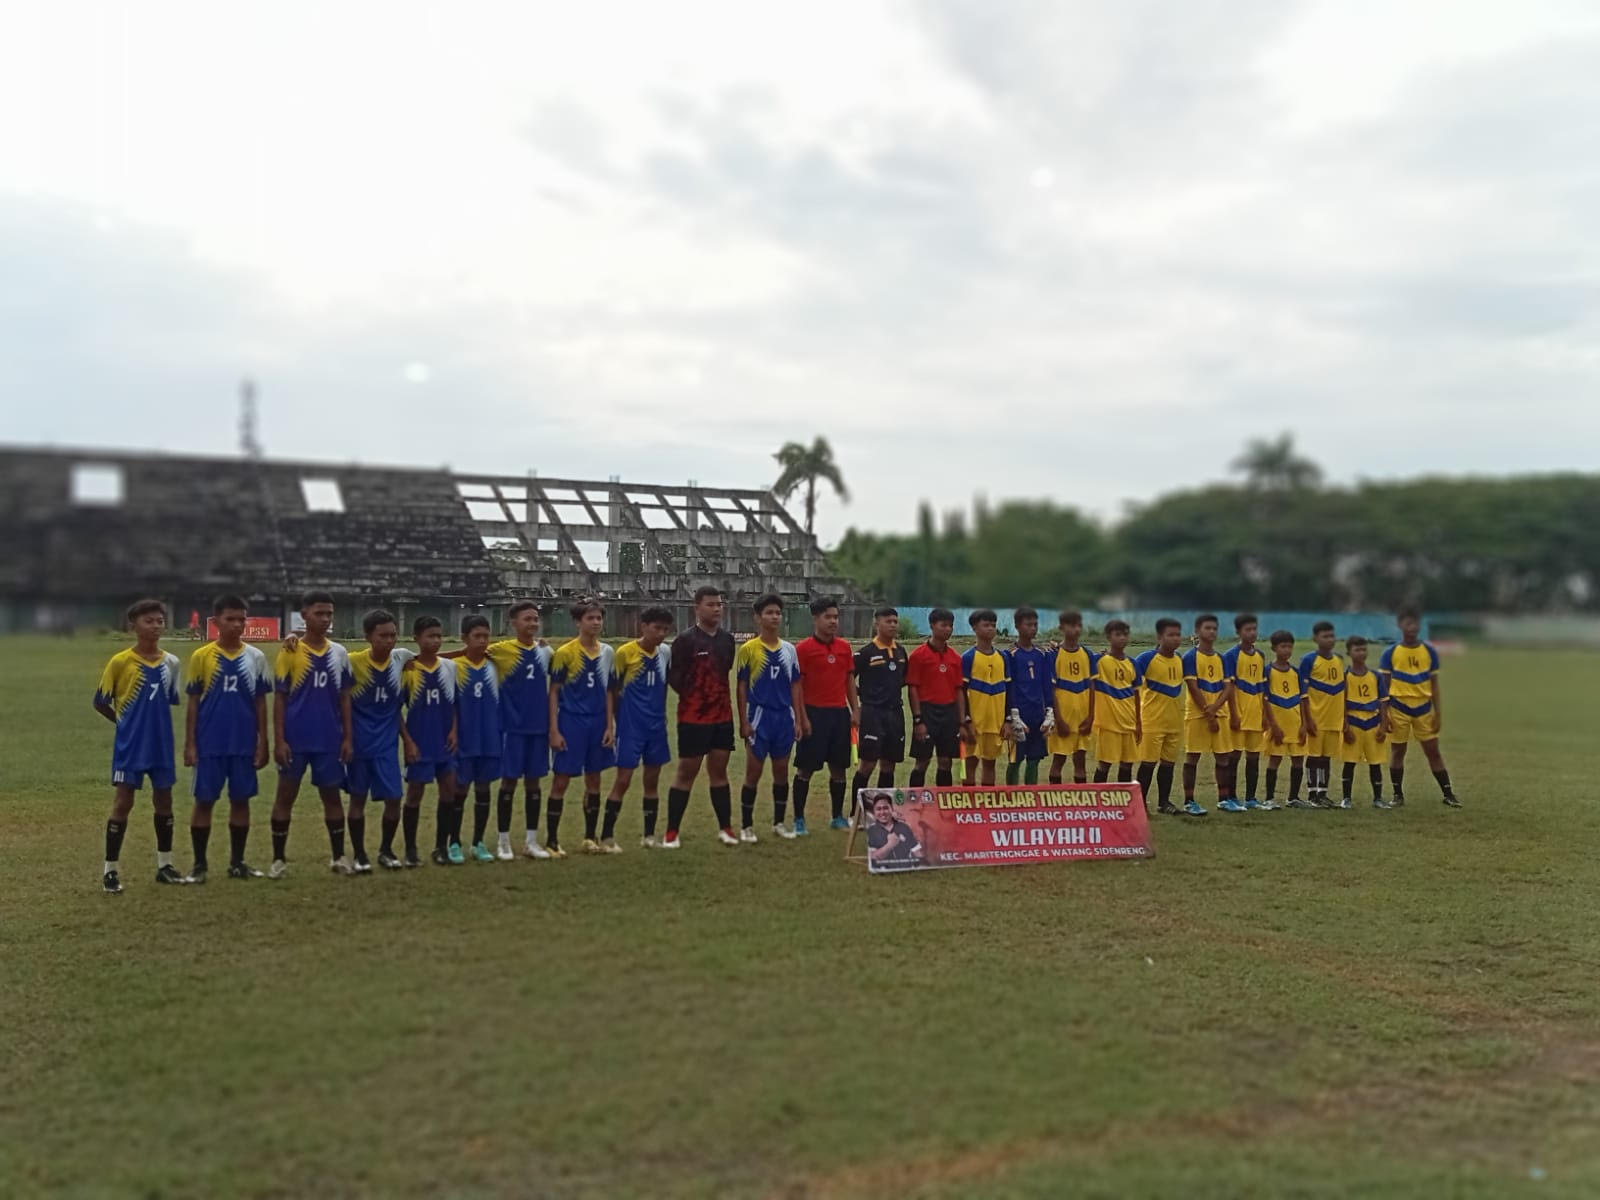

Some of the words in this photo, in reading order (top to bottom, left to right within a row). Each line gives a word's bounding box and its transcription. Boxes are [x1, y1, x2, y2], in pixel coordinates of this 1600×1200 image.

[249, 626, 270, 636] PSSI
[1069, 661, 1080, 676] 19
[1408, 655, 1419, 669] 14
[526, 665, 535, 680] 2
[770, 665, 781, 680] 17
[987, 664, 995, 679] 7
[1028, 666, 1035, 680] 1
[1114, 667, 1125, 682] 13
[1168, 667, 1177, 681] 11
[1207, 665, 1215, 678] 3
[1248, 663, 1258, 677] 17
[1327, 667, 1338, 681] 10
[223, 675, 238, 692] 12
[313, 671, 328, 688] 10
[587, 672, 595, 688] 5
[646, 671, 656, 687] 11
[149, 683, 159, 701] 7
[474, 682, 483, 698] 8
[1282, 680, 1290, 694] 8
[1357, 684, 1370, 697] 12
[375, 687, 389, 703] 14
[426, 688, 440, 705] 19
[938, 792, 973, 809] LIGA
[975, 791, 1036, 808] PELAJAR
[1038, 790, 1097, 807] TINGKAT
[1100, 790, 1131, 807] SMP
[956, 813, 986, 824] KAB.
[990, 811, 1062, 823] SIDENRENG
[1065, 810, 1125, 821] RAPPANG
[991, 827, 1085, 847] WILAYAH
[1089, 827, 1102, 844] II
[940, 853, 963, 861] KEC.
[965, 850, 1041, 860] MARITENGNGAE
[1042, 849, 1049, 857] &
[1051, 848, 1092, 857] WATANG
[1094, 846, 1145, 856] SIDENRENG
